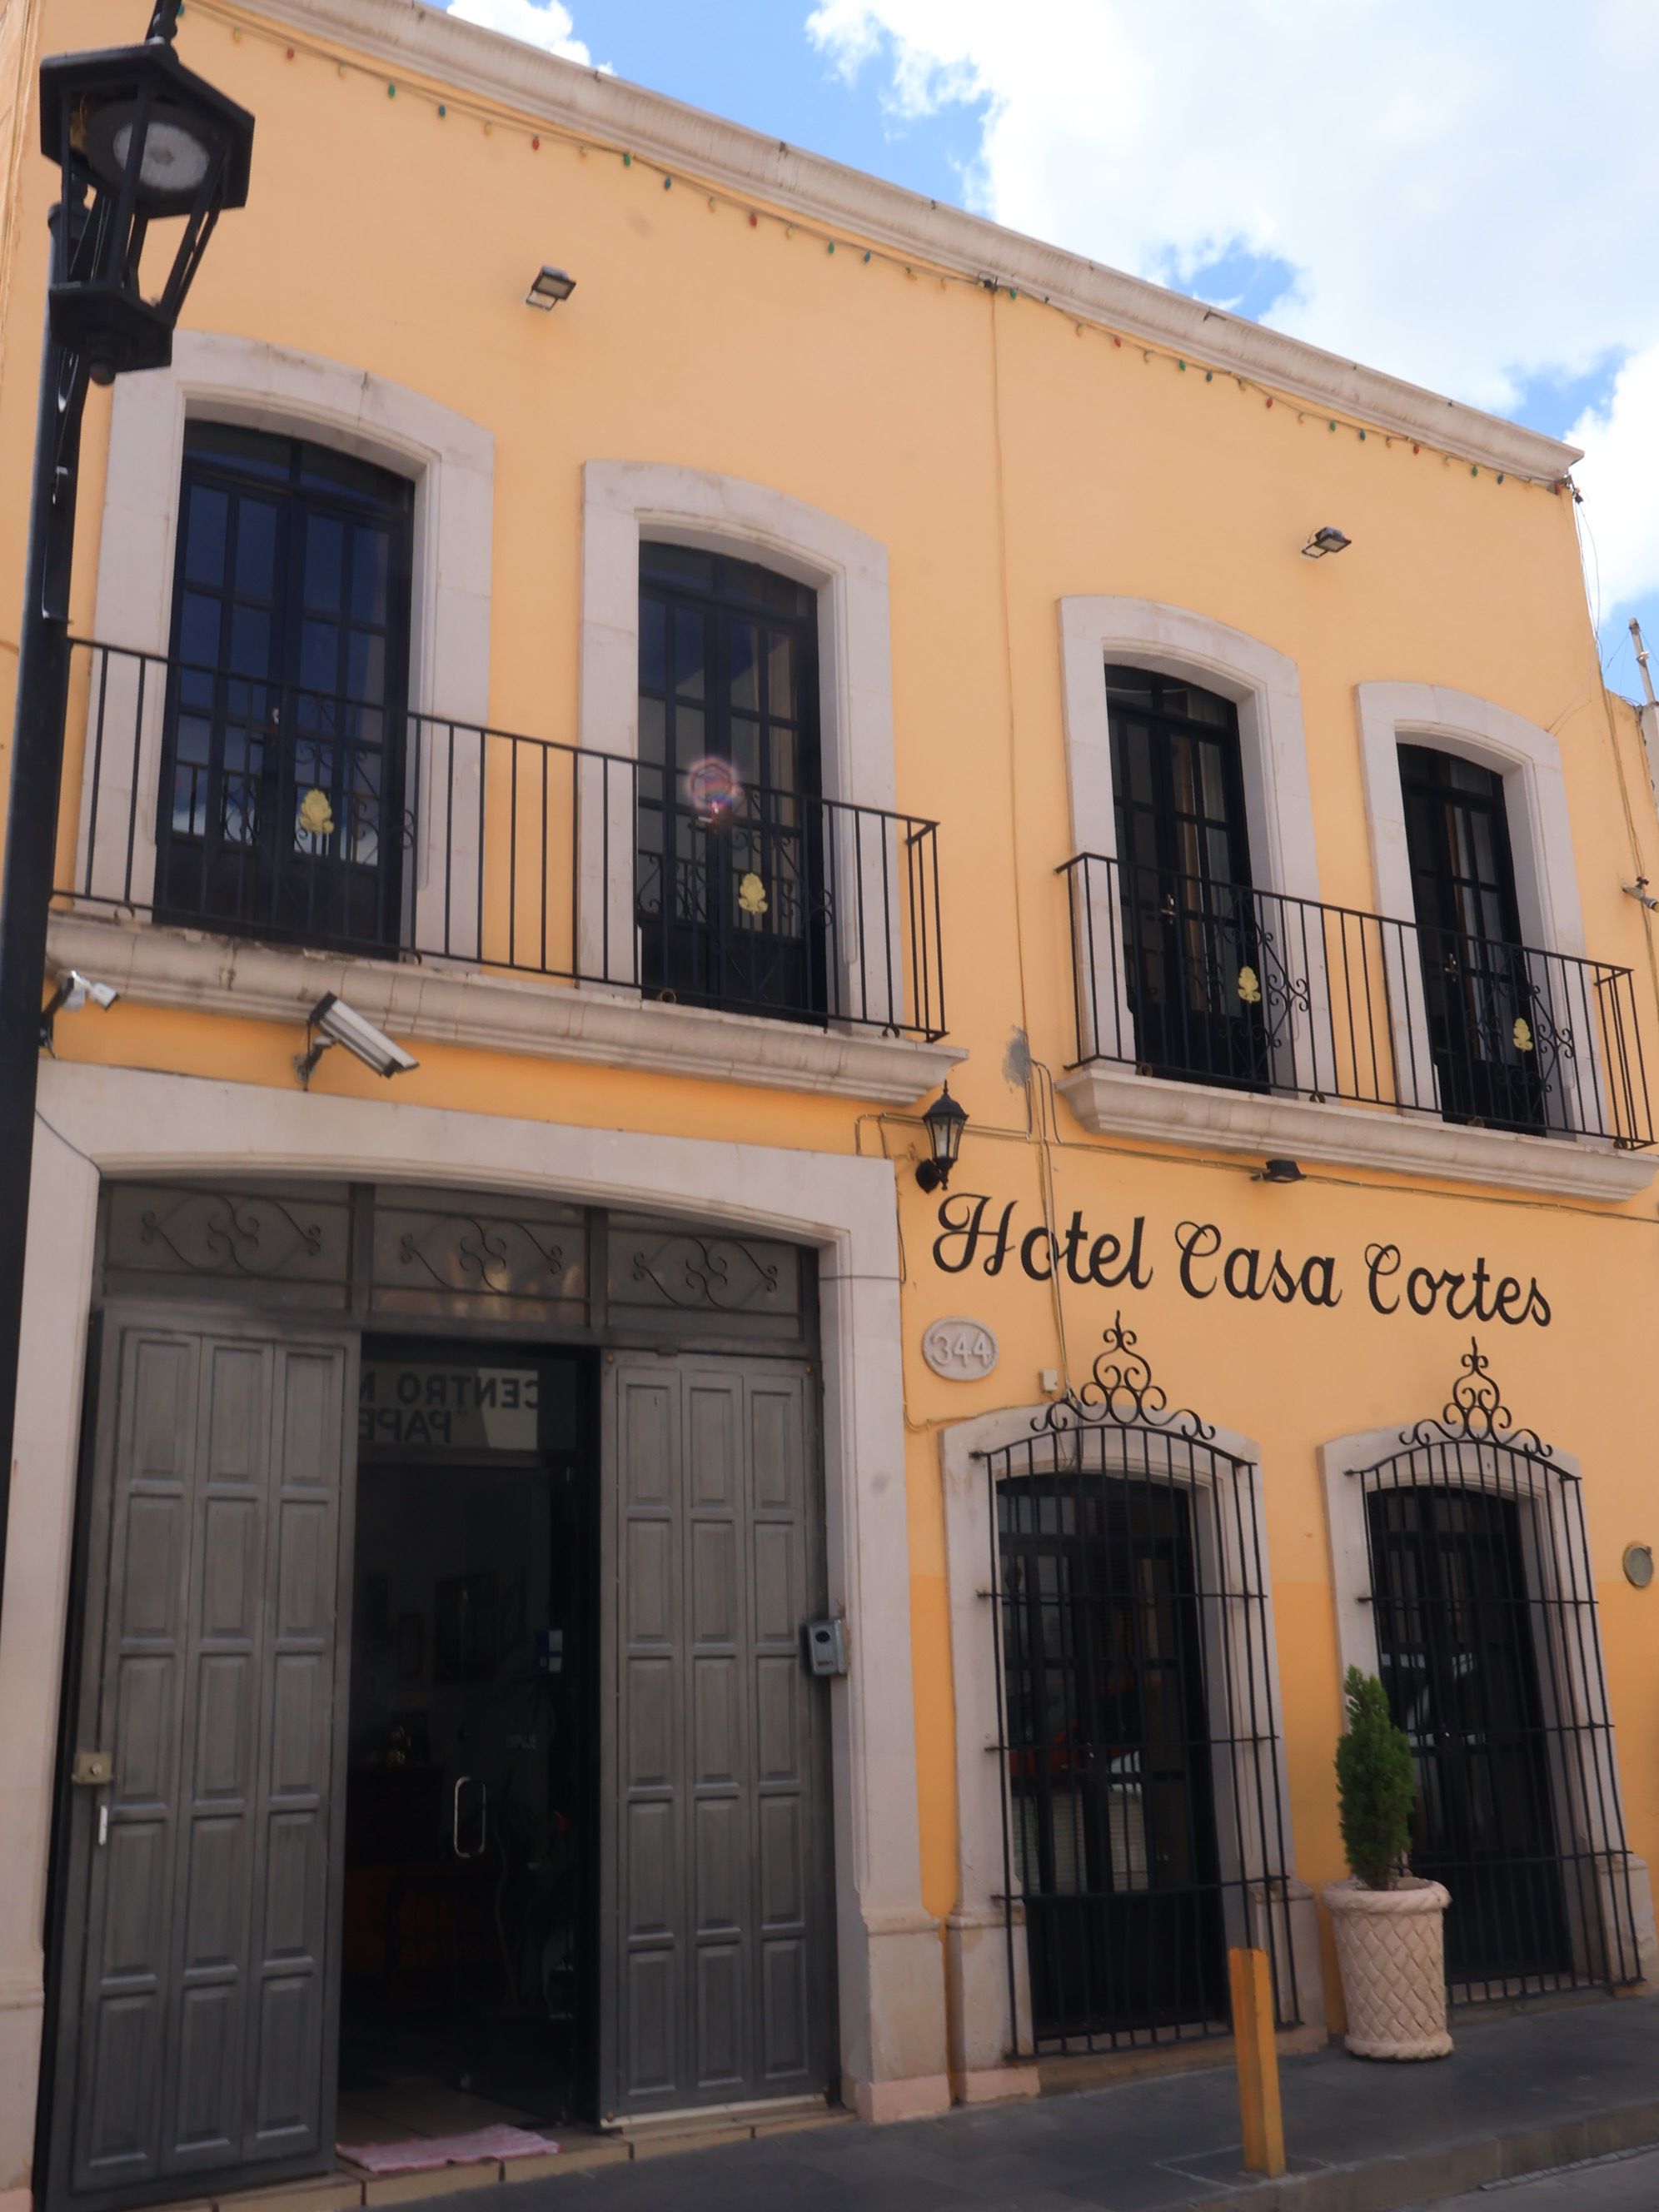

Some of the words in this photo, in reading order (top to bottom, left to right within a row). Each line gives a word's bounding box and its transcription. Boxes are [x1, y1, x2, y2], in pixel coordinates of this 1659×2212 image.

[932, 1193, 1153, 1289] Hotel
[1175, 1221, 1342, 1308] Casa
[1365, 1243, 1552, 1327] Cortes
[929, 1332, 992, 1368] 344
